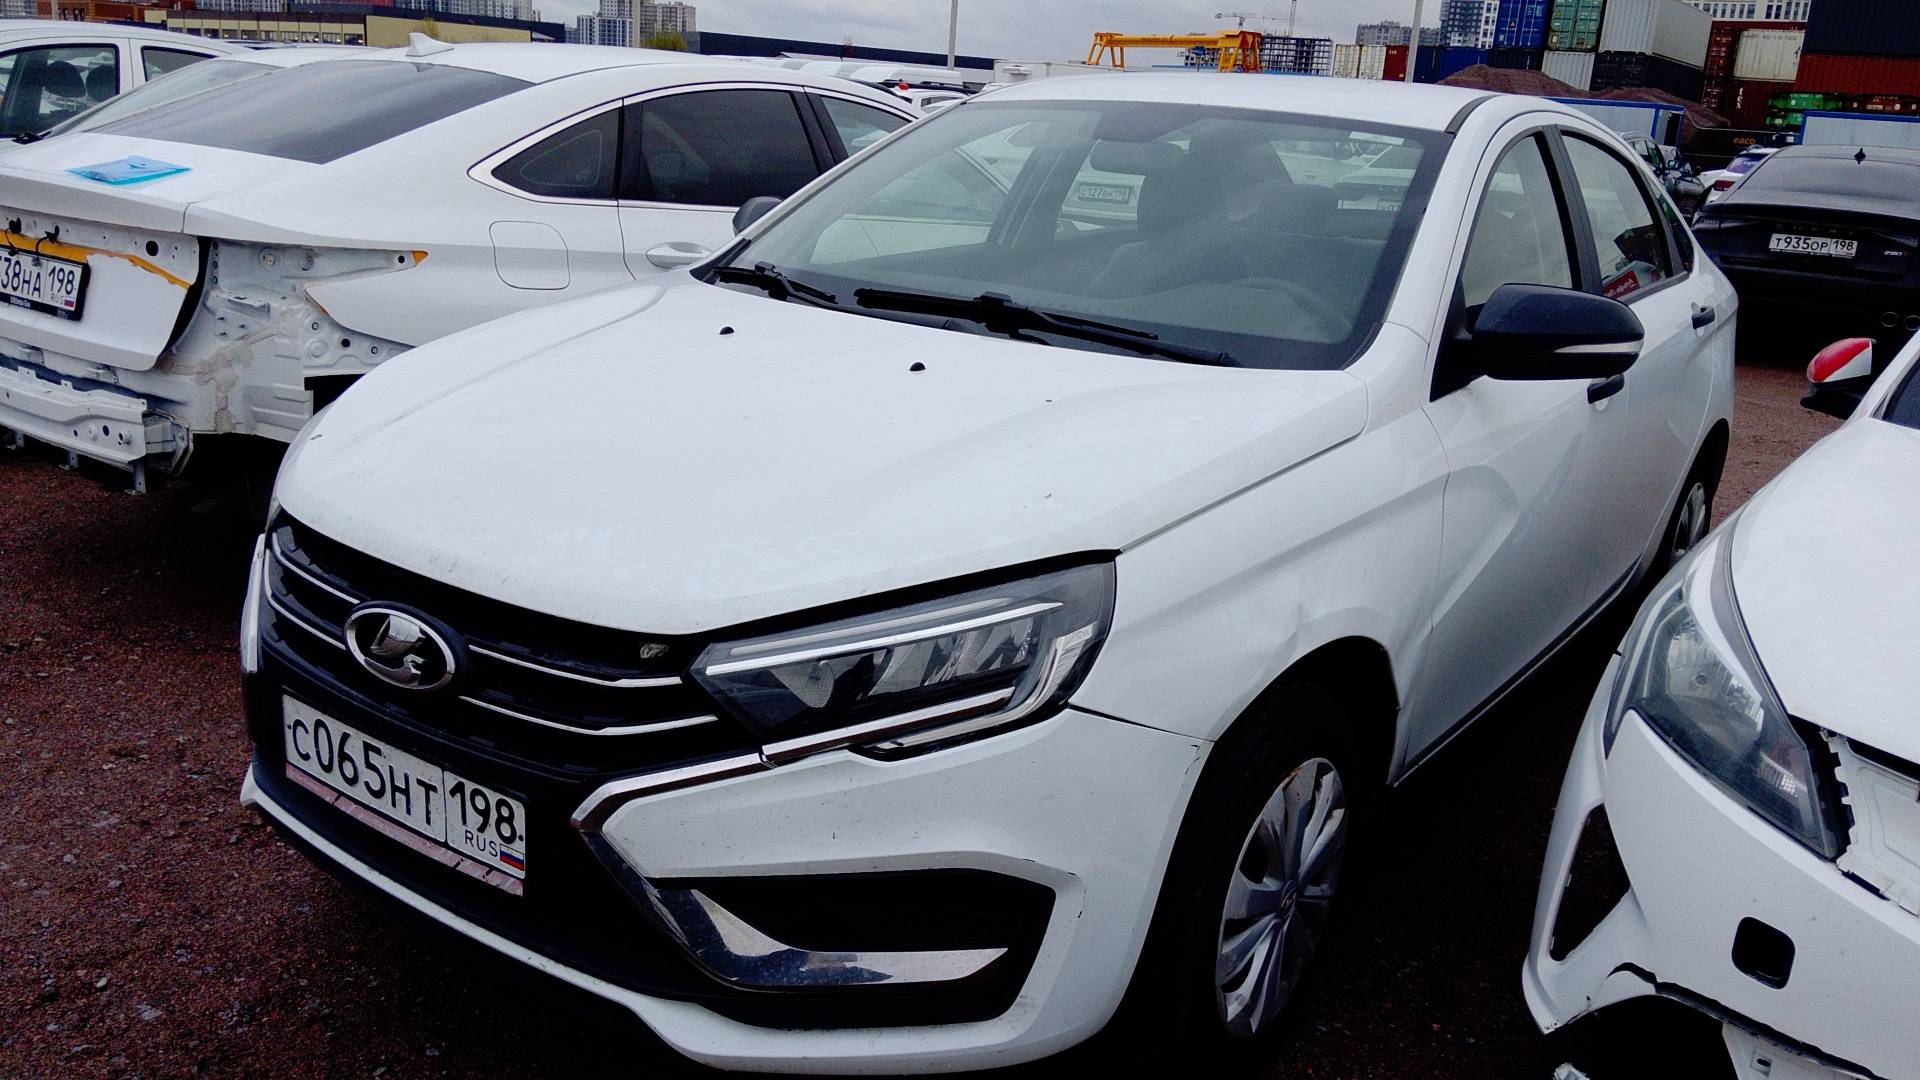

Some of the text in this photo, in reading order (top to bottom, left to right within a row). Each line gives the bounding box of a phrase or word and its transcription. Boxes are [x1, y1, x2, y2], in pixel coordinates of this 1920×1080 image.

[1775, 236, 1854, 251] Т935ОР 198
[0, 255, 76, 299] 38НА 198
[51, 292, 65, 305] RUS
[292, 718, 518, 845] С065НТ 198
[465, 829, 498, 857] RUS
